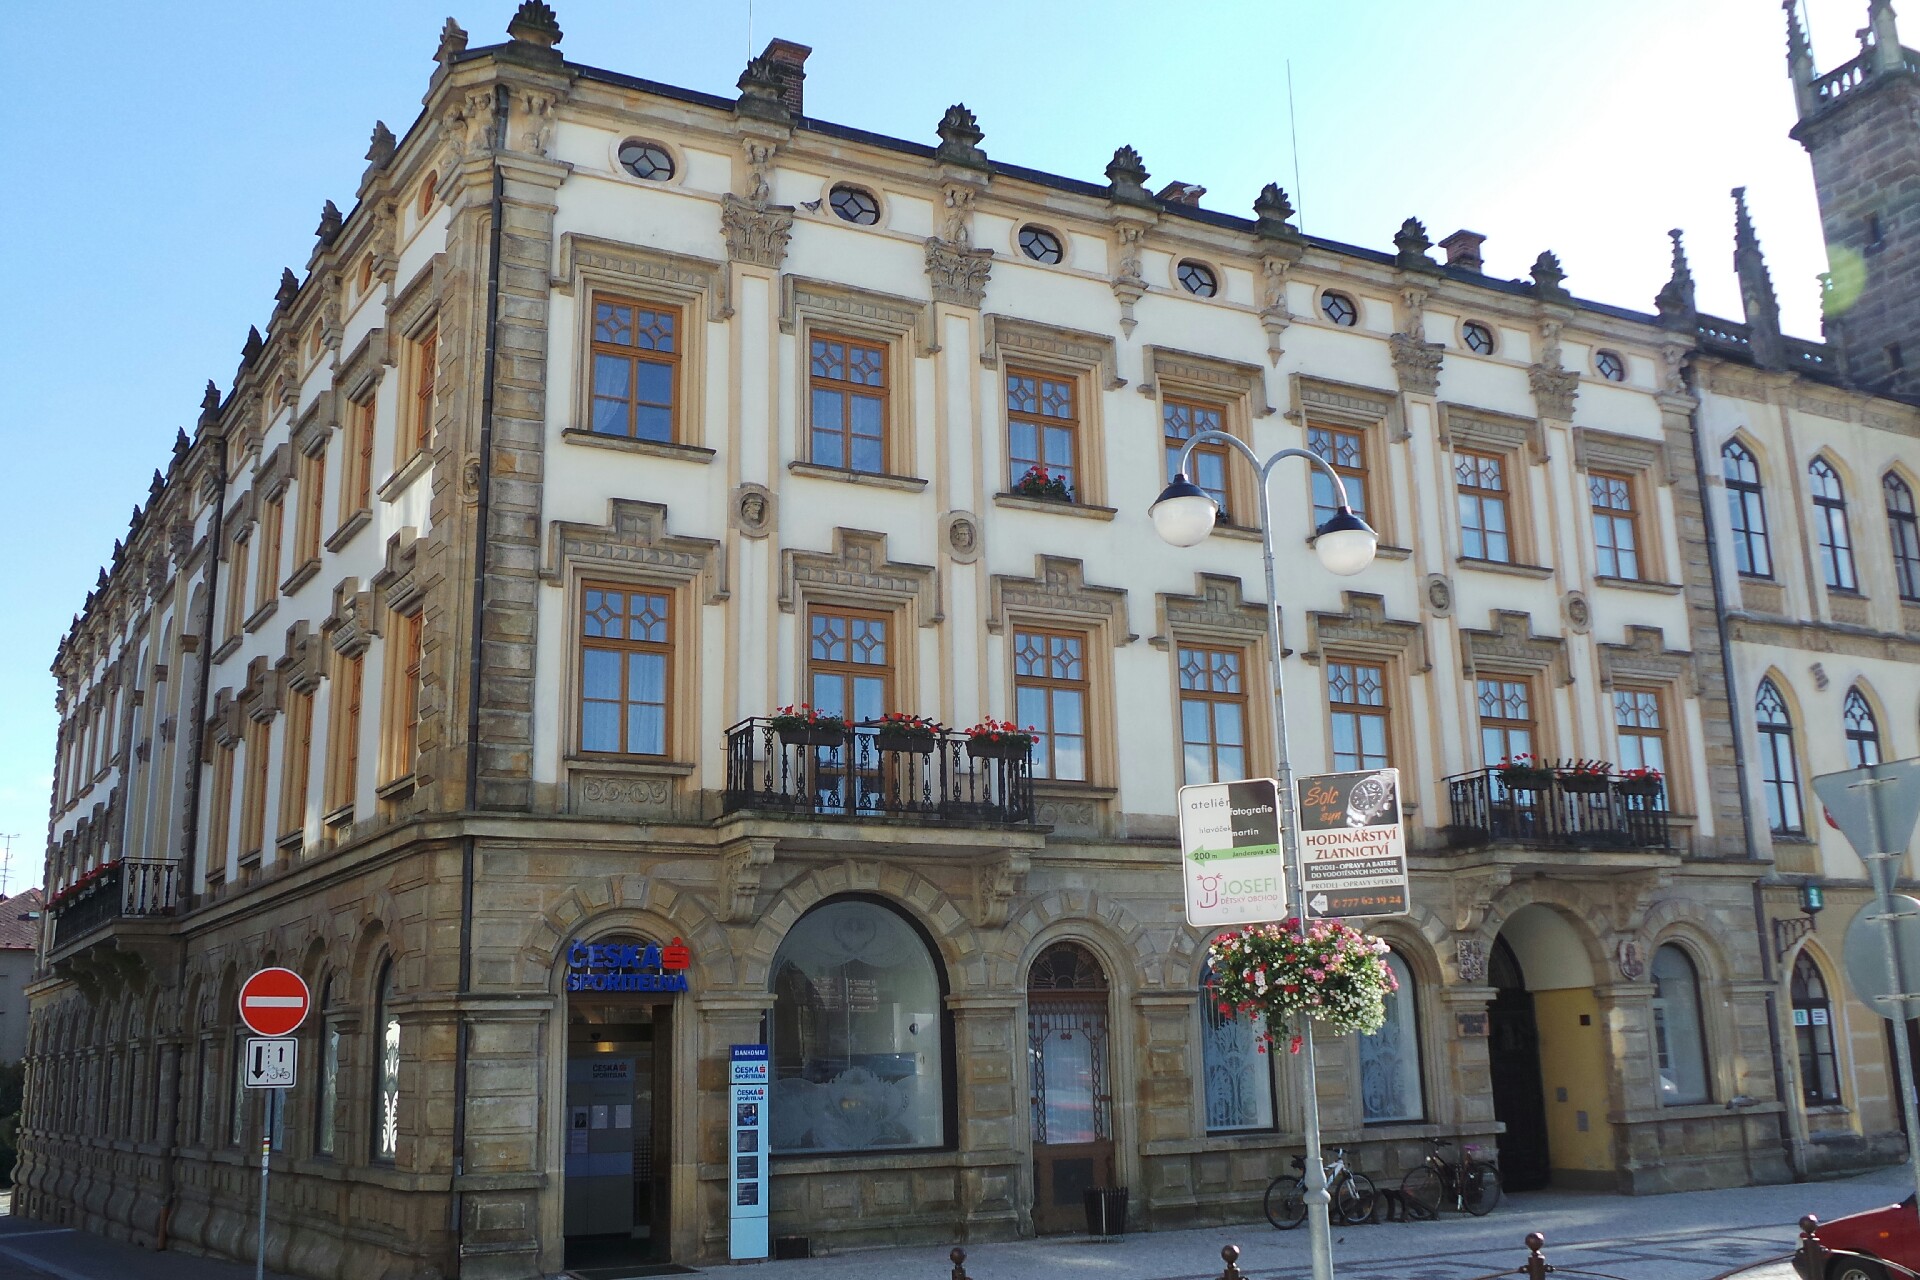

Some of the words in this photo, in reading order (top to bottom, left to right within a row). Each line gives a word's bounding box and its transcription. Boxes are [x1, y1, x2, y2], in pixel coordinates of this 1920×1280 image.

[1304, 781, 1338, 806] Šolc
[1191, 798, 1230, 810] ateliér
[1230, 804, 1274, 817] fotografie
[1320, 811, 1342, 825] syn
[1199, 825, 1232, 834] hlaváček
[1232, 828, 1259, 837] martin
[1306, 827, 1397, 847] HODINÁŘSTVÍ
[1194, 852, 1210, 861] 200
[1315, 842, 1390, 860] ZLATNICTVÍ
[1310, 864, 1335, 872] PRODEJ
[1339, 862, 1365, 870] OPRAVY
[1322, 869, 1368, 878] VODOTĚSNÝCH
[1369, 867, 1399, 875] HODINEK
[1220, 877, 1277, 896] JOSEFI
[1311, 882, 1338, 890] PRODEJ
[1343, 880, 1371, 888] OPRAVY
[1247, 894, 1278, 903] OBCHOD
[1342, 898, 1360, 908] 777
[1388, 895, 1402, 904] 24
[566, 938, 663, 969] ČESKÁ
[566, 969, 689, 993] SPOŘITELNA
[734, 1064, 759, 1074] ČESKÁ
[736, 1088, 758, 1096] ČESKÁ
